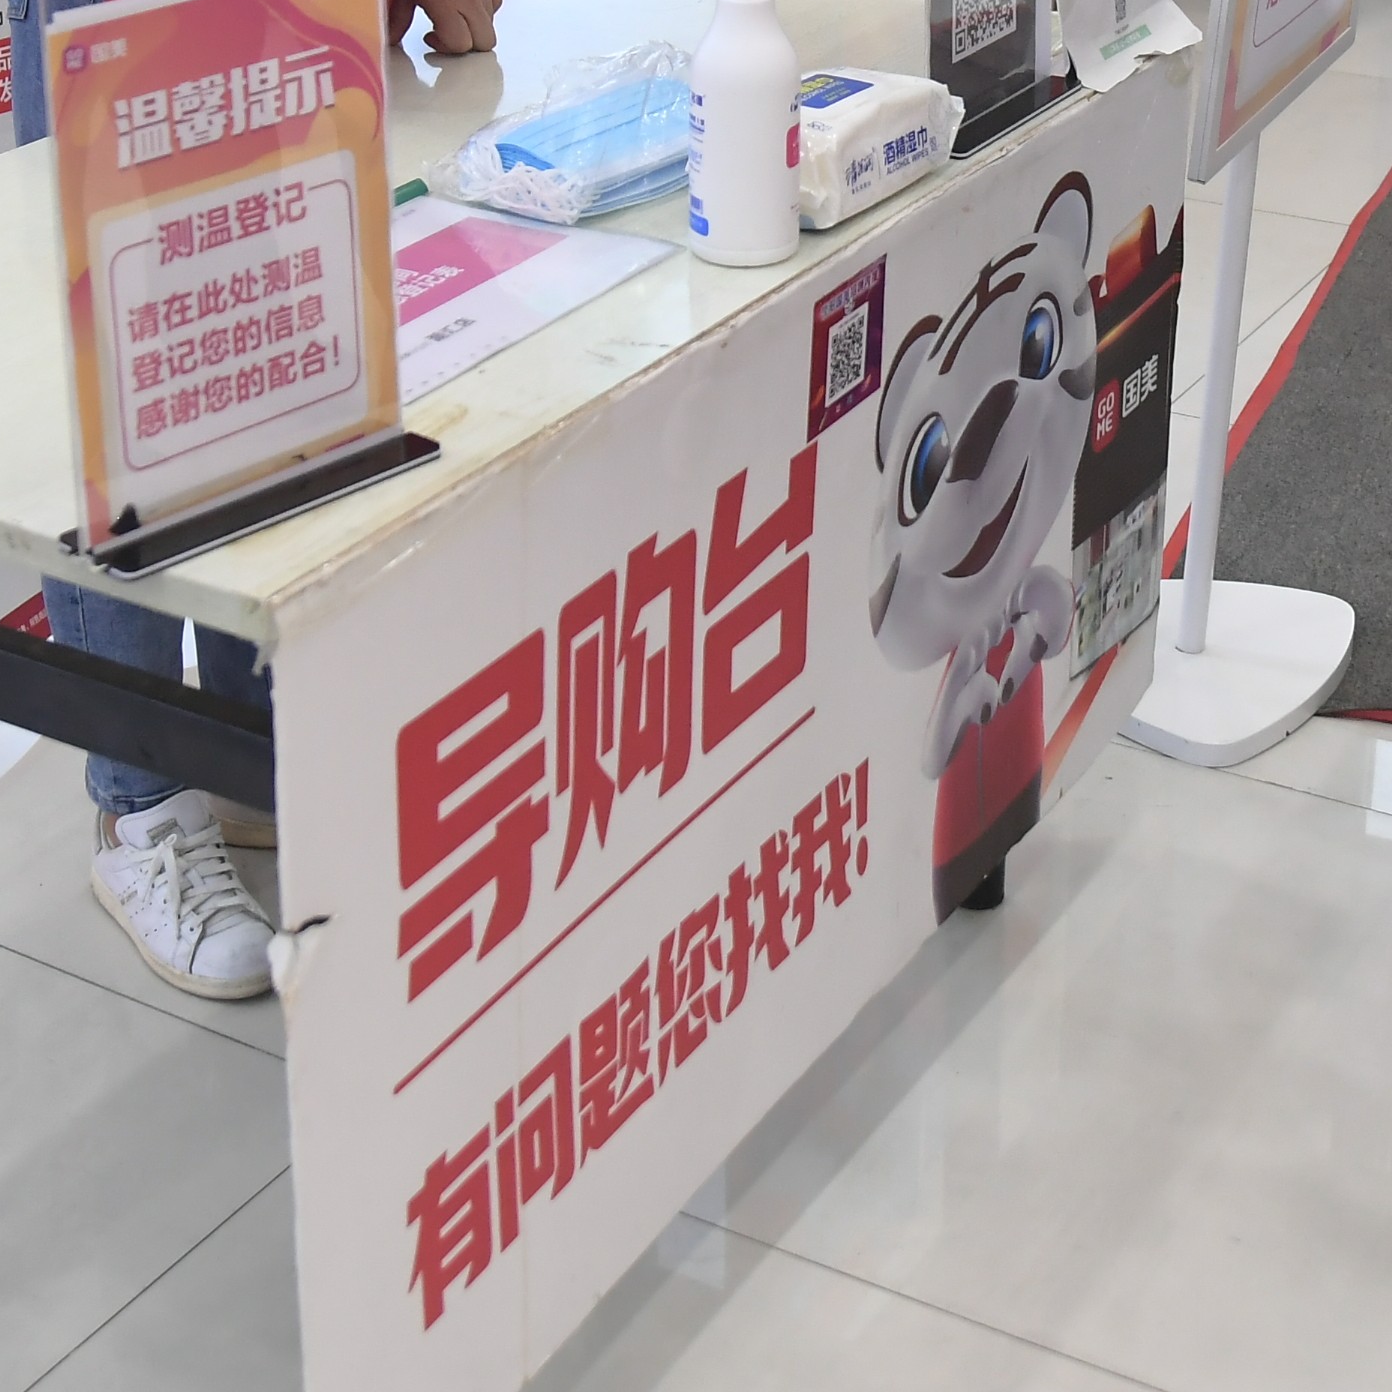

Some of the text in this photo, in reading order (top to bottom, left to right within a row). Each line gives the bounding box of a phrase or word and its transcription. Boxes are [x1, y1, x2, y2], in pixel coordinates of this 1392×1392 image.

[114, 44, 336, 170] 温馨提示
[883, 125, 928, 166] 酒精湿巾
[886, 149, 929, 176] ALCOHOL WIPES
[157, 181, 308, 266] 测温登记
[127, 245, 323, 344] 请在此处测温
[132, 293, 326, 394] 登记您的信息
[136, 334, 340, 440] 感谢您的配合!
[1122, 353, 1159, 418] 国美
[1096, 412, 1113, 442] ME
[1097, 391, 1115, 420] GO
[396, 440, 816, 1005] 导购台
[407, 758, 870, 1332] 有问题您找我!
